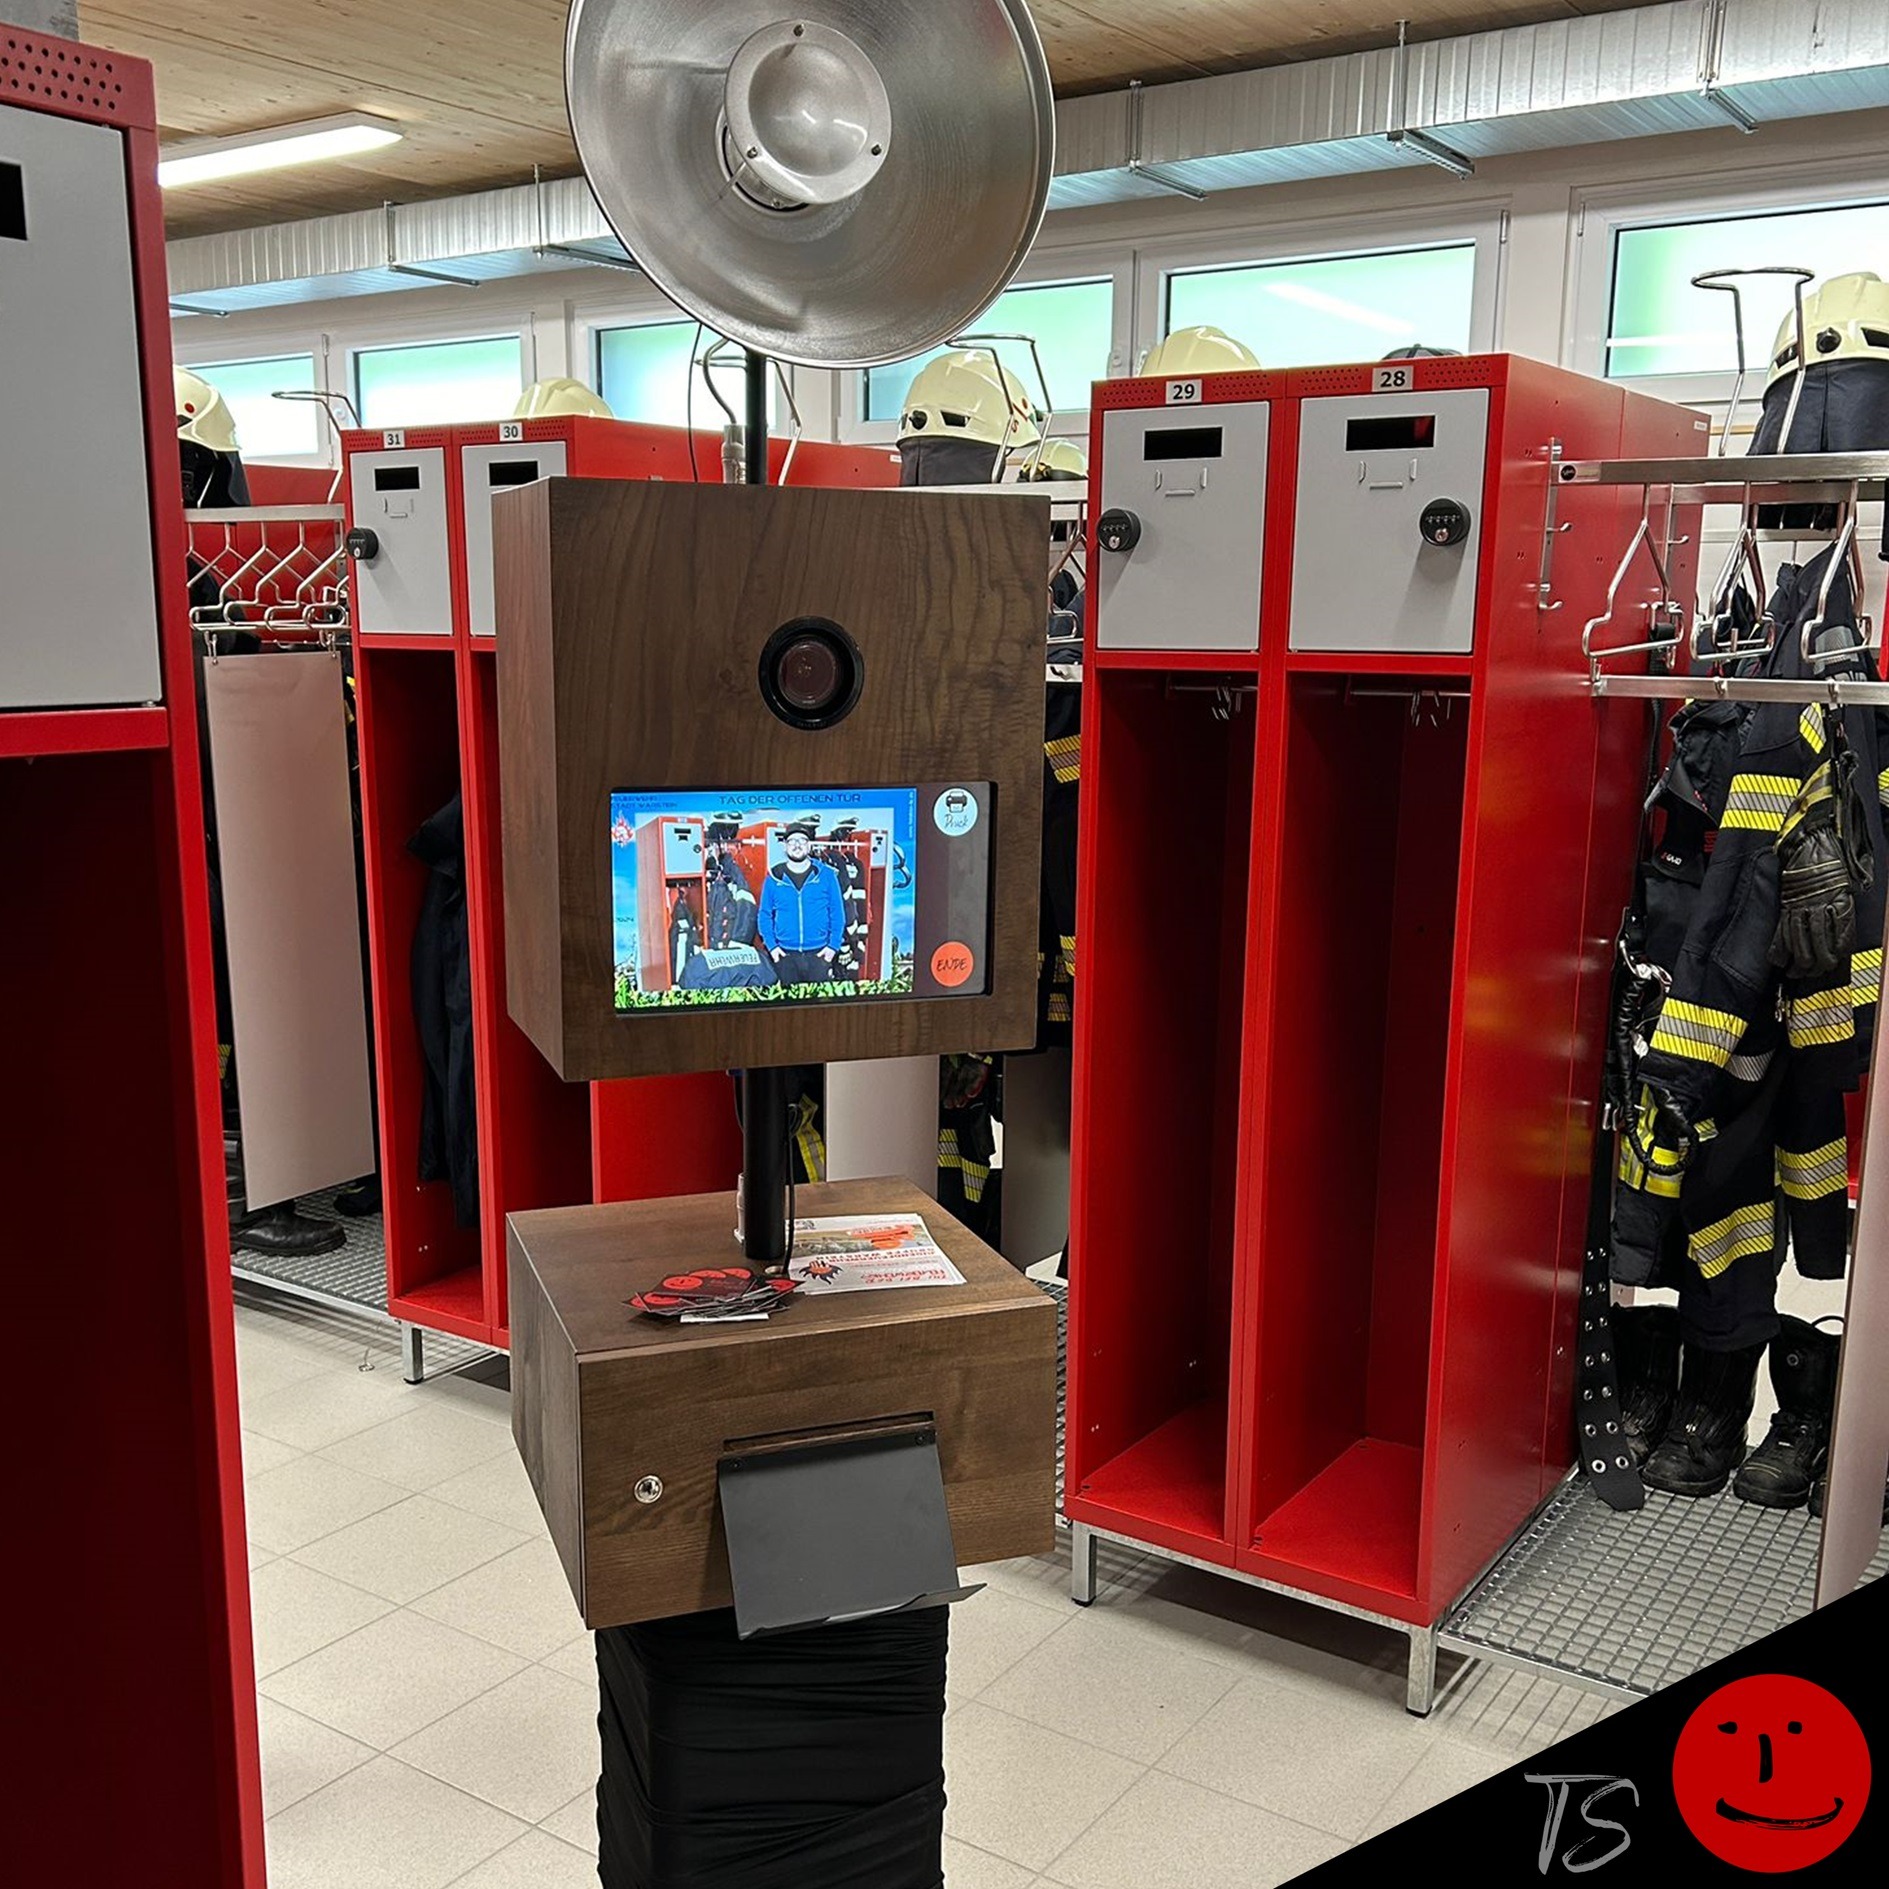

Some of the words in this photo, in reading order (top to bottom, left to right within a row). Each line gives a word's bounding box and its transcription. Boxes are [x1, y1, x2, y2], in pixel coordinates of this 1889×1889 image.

[1380, 370, 1406, 388] 28
[1172, 384, 1196, 400] 29
[503, 425, 519, 439] 30
[387, 433, 401, 446] 31
[719, 795, 746, 805] TAG
[748, 795, 775, 804] DER
[777, 794, 834, 804] OFFENEN
[936, 957, 968, 972] ENDE
